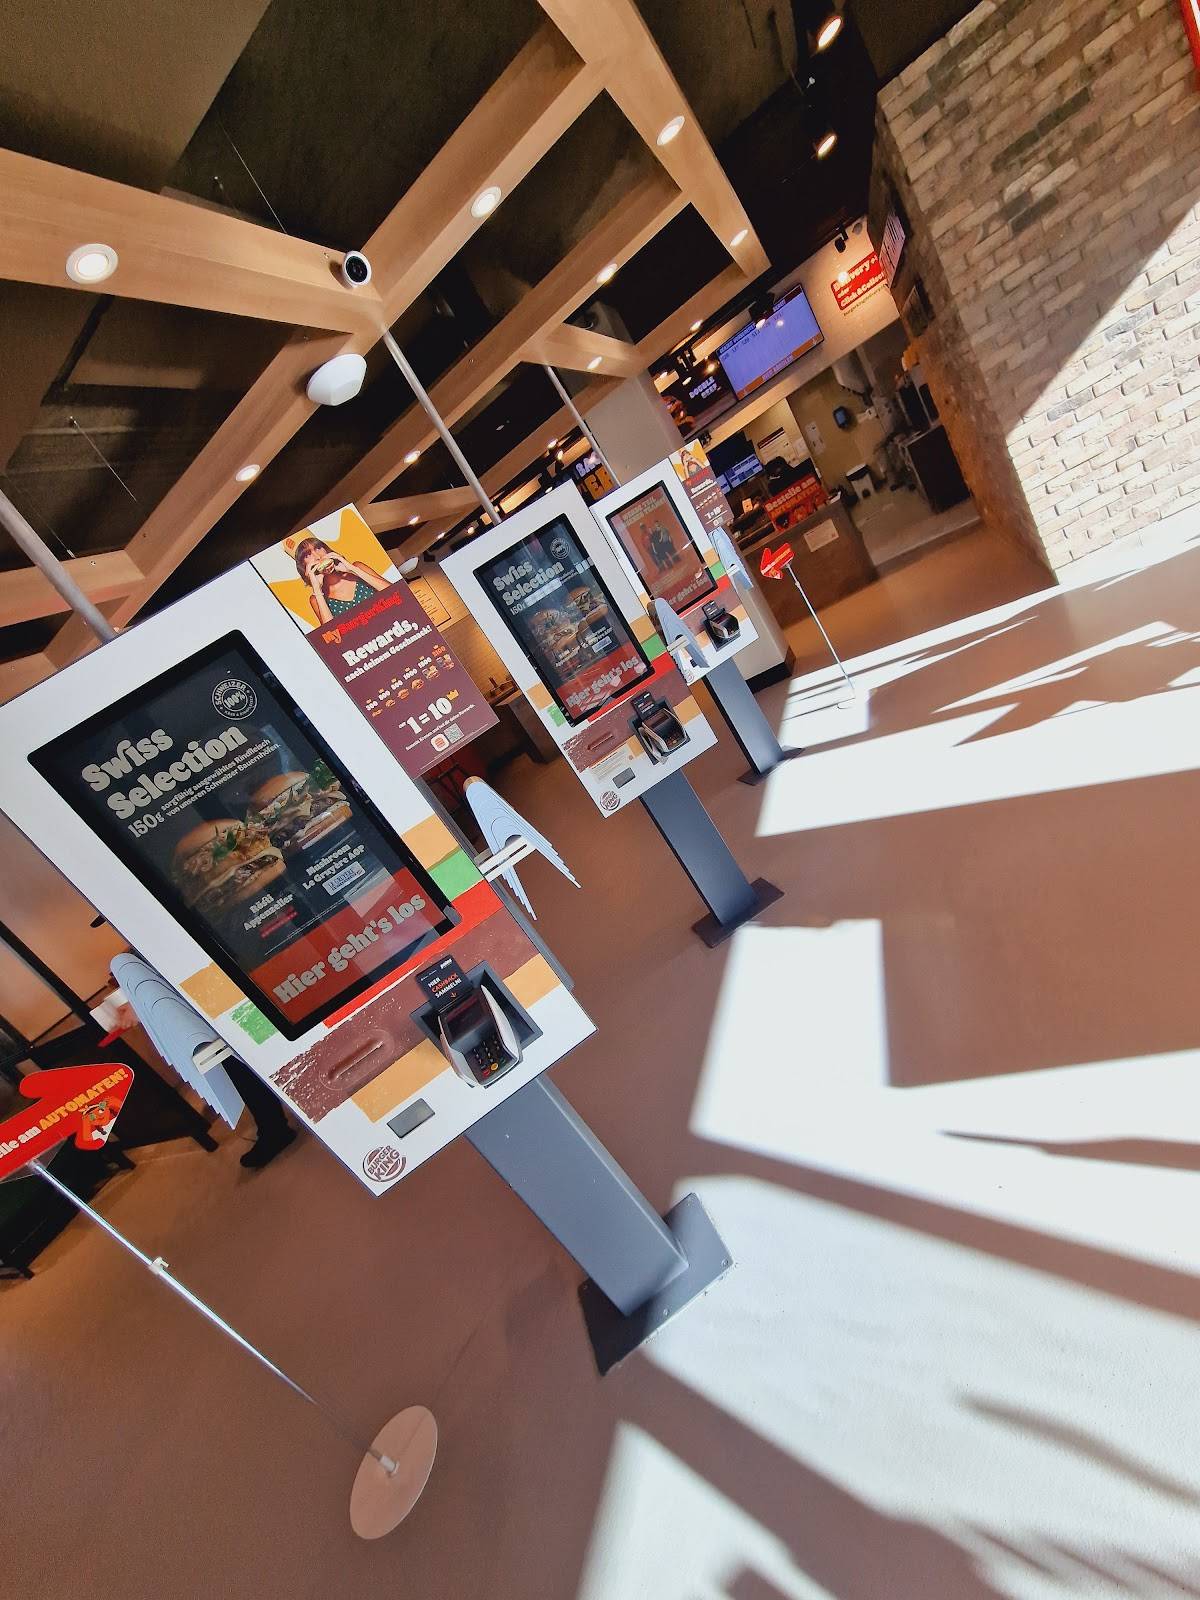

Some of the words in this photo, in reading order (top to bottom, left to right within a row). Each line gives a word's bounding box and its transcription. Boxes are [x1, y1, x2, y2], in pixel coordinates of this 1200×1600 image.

[493, 562, 532, 591] Swiss
[503, 562, 565, 605] Selection
[342, 620, 419, 667] Rewards,
[345, 667, 365, 683] nach
[363, 651, 392, 671] deinem
[389, 625, 433, 655] Geschmack!
[620, 656, 639, 671] los
[214, 681, 247, 706] SCHWEIZER
[407, 716, 422, 734] 1
[419, 713, 430, 724] =
[428, 697, 452, 720] 10
[82, 728, 173, 791] Swiss
[107, 726, 248, 819] Selection
[161, 787, 194, 811] sorgfältig
[193, 762, 236, 791] ausgewähltes
[234, 739, 271, 764] Rindfleisch
[166, 806, 181, 817] von
[180, 789, 206, 809] unseren
[205, 770, 239, 793] Schweizer
[238, 743, 280, 772] Bauernhöfen.
[127, 811, 164, 838] 150g
[302, 880, 321, 890] Le
[313, 857, 350, 883] Gruyère
[348, 844, 365, 860] AOP
[306, 844, 351, 876] Mushroom
[244, 894, 293, 930] Appenzeller
[272, 961, 326, 1004] Hier
[328, 917, 393, 972] geht's
[387, 894, 426, 925] los
[428, 977, 440, 988] HIER
[432, 973, 458, 993] CASHBACK
[18, 1126, 42, 1144] am
[40, 1068, 129, 1131] AUTOMATEN!
[368, 1145, 392, 1174] BURGER
[374, 1150, 400, 1180] KING
